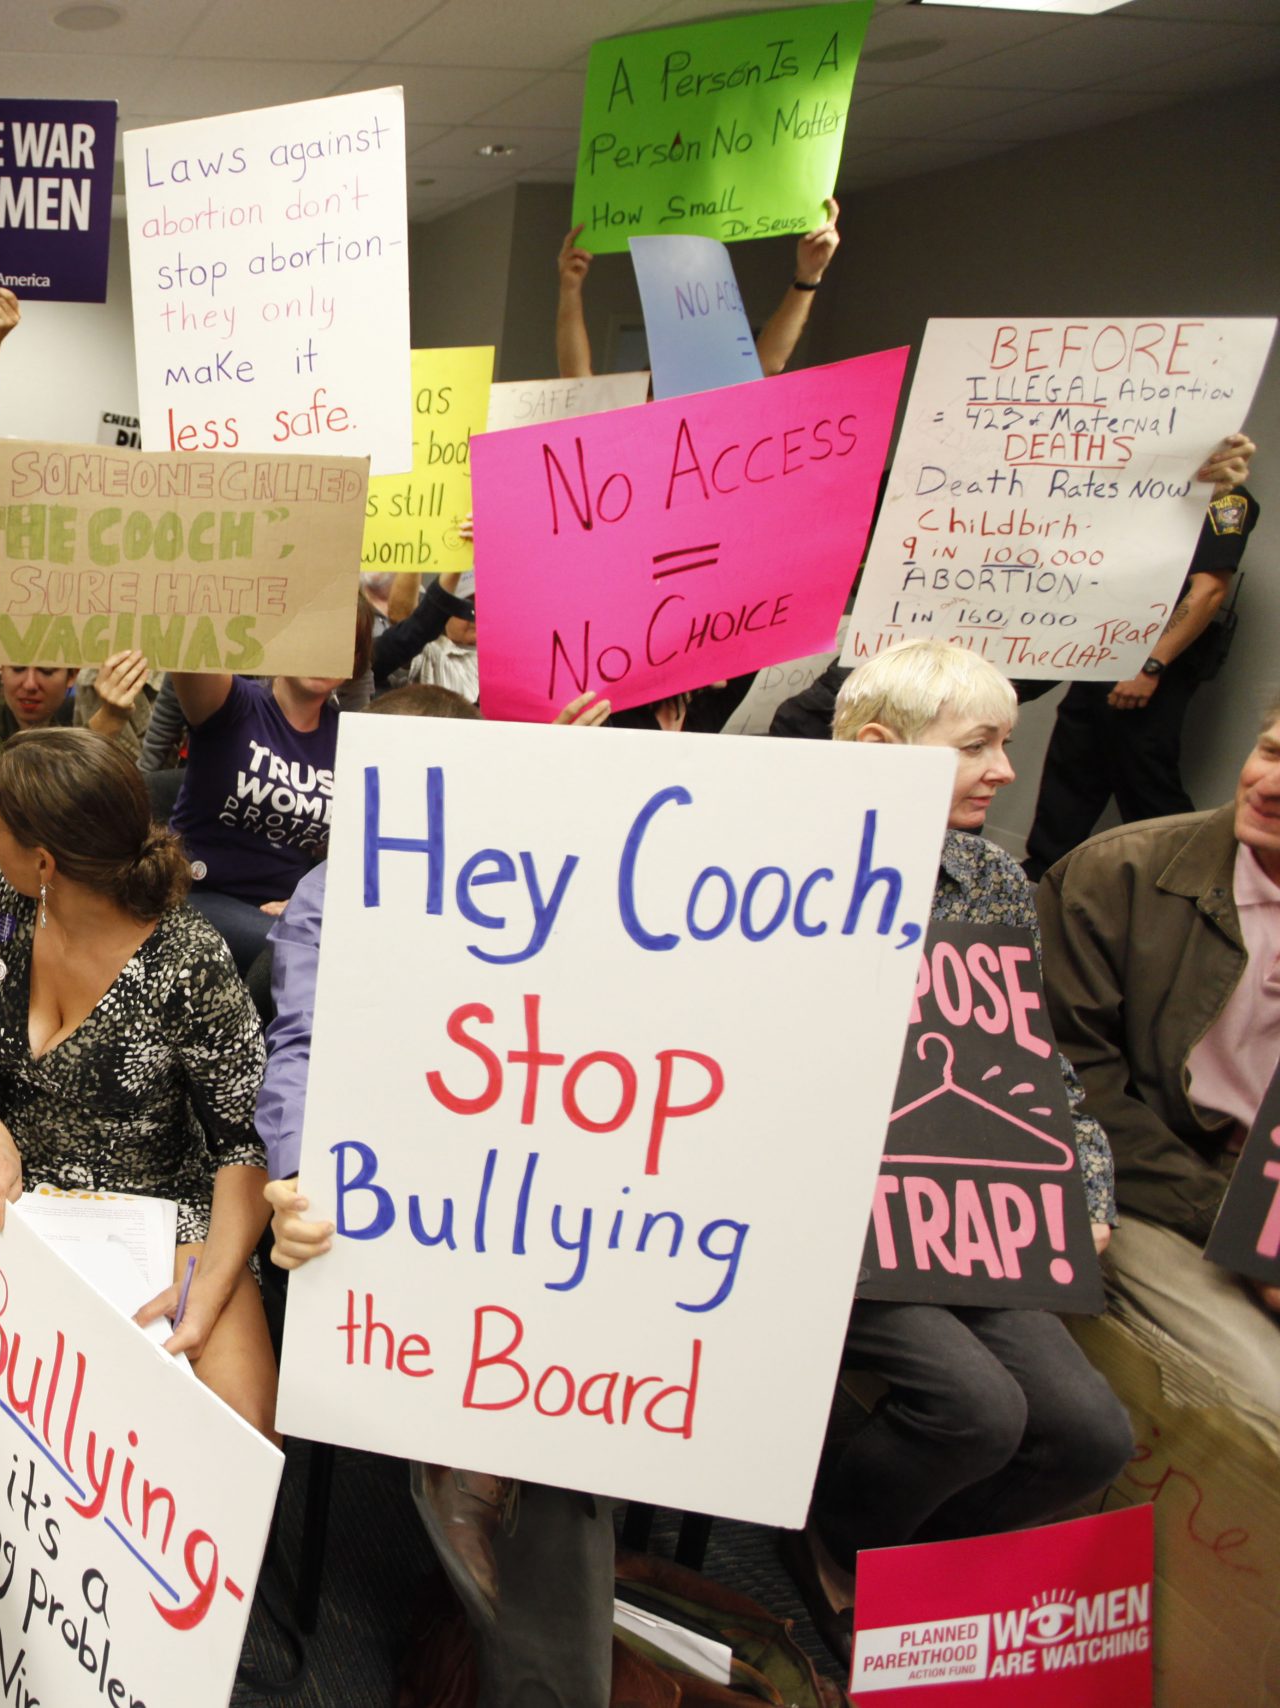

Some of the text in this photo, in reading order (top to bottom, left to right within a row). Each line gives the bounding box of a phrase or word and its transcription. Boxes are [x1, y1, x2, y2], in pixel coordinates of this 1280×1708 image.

[608, 31, 839, 112] A Person Is A
[11, 122, 96, 169] WAR
[146, 116, 391, 187] Laws against
[589, 99, 844, 175] Person No Matter
[142, 176, 370, 238] abortion don't
[592, 186, 743, 232] How Small
[753, 217, 807, 236] Seuss
[158, 252, 227, 296] stop
[160, 285, 335, 340] they only
[675, 282, 710, 320] NO
[296, 338, 319, 374] it
[416, 387, 452, 415] as
[966, 375, 1234, 403] ILLEGAL Abortion
[168, 388, 357, 452] less safe.
[428, 427, 470, 476] bod
[1004, 433, 1135, 461] DEATHS
[11, 451, 215, 499] SOMEONE
[219, 459, 362, 503] CALLED
[388, 483, 444, 517] still
[915, 466, 1024, 497] Death
[1047, 470, 1119, 499] Rates
[652, 543, 721, 580] =
[902, 569, 1082, 595] ABORTION
[983, 547, 1104, 570] 100,000
[7, 565, 140, 616] SURE
[153, 573, 289, 616] HATE
[646, 594, 795, 668] CHOICE
[958, 608, 1077, 629] 160,000
[1002, 636, 1050, 666] The
[248, 739, 335, 797] TRUS
[363, 765, 923, 965] Hey Cooch,
[426, 994, 725, 1175] Stop
[330, 1141, 751, 1313] Bullying
[870, 1174, 1075, 1285] TRAP!
[336, 1289, 703, 1440] the Board
[6, 1454, 111, 1629] it's a
[863, 1644, 978, 1672] PARENTHOOD
[900, 1622, 979, 1648] PLANNED
[988, 1627, 1150, 1680] ARE WATCHING
[908, 1664, 976, 1681] ACTION FUND
